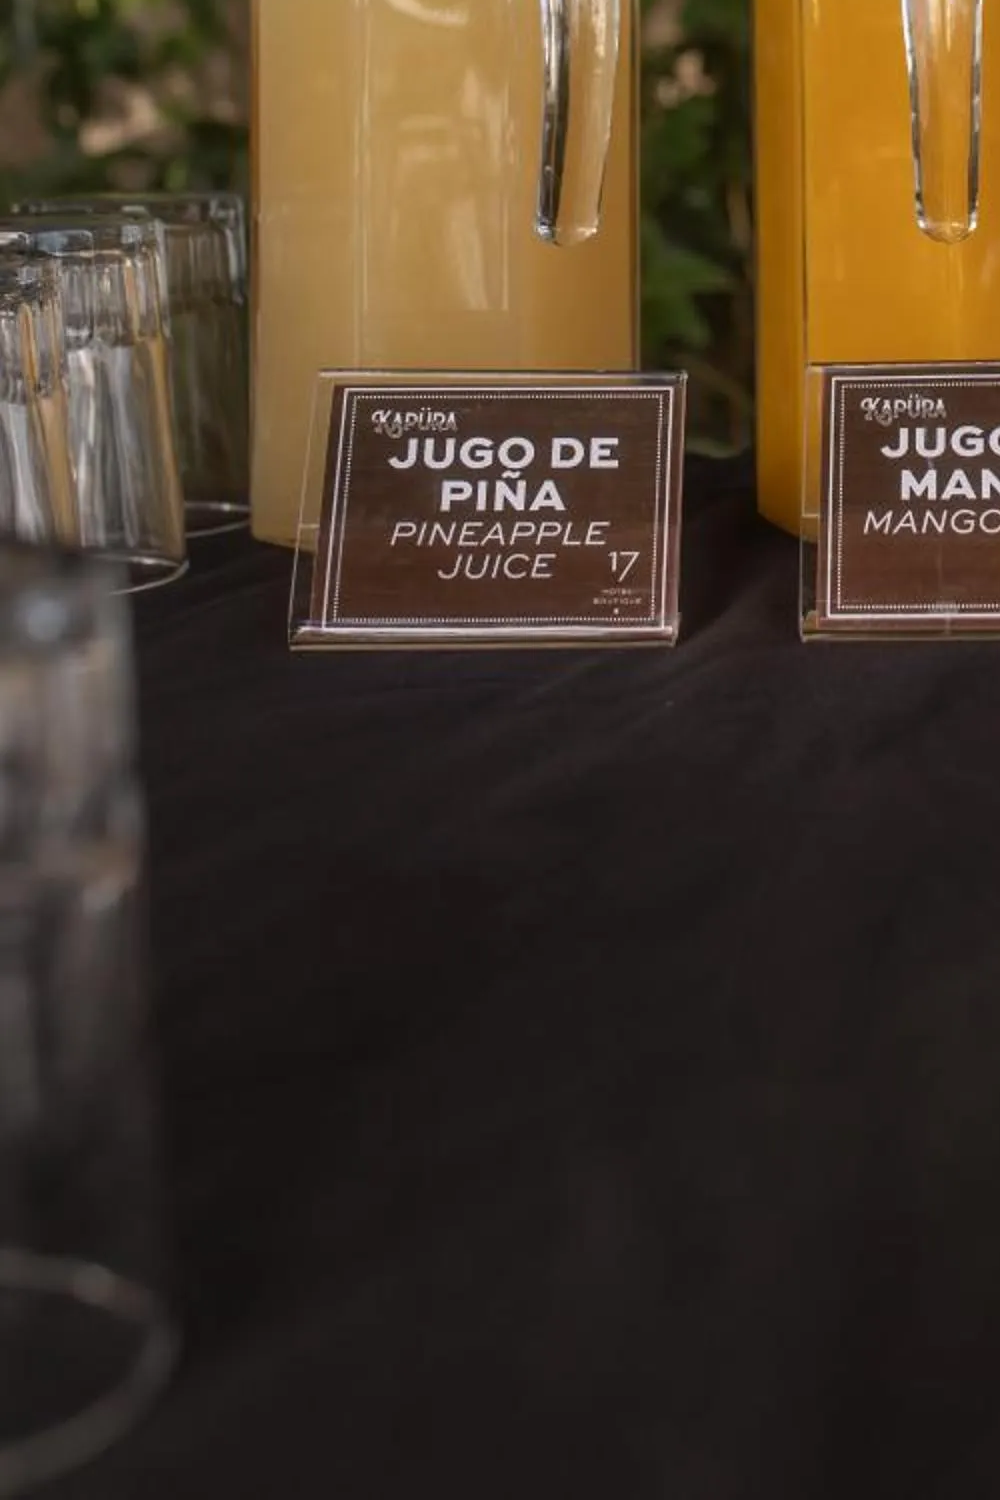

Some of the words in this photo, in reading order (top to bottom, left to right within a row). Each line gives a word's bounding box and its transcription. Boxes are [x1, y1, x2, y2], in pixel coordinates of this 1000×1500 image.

[388, 437, 535, 469] JUGO
[550, 437, 619, 469] DE
[440, 471, 566, 512] PIÑA
[390, 521, 611, 547] PINEAPPLE
[437, 553, 557, 580] JUICE
[608, 551, 640, 582] 17
